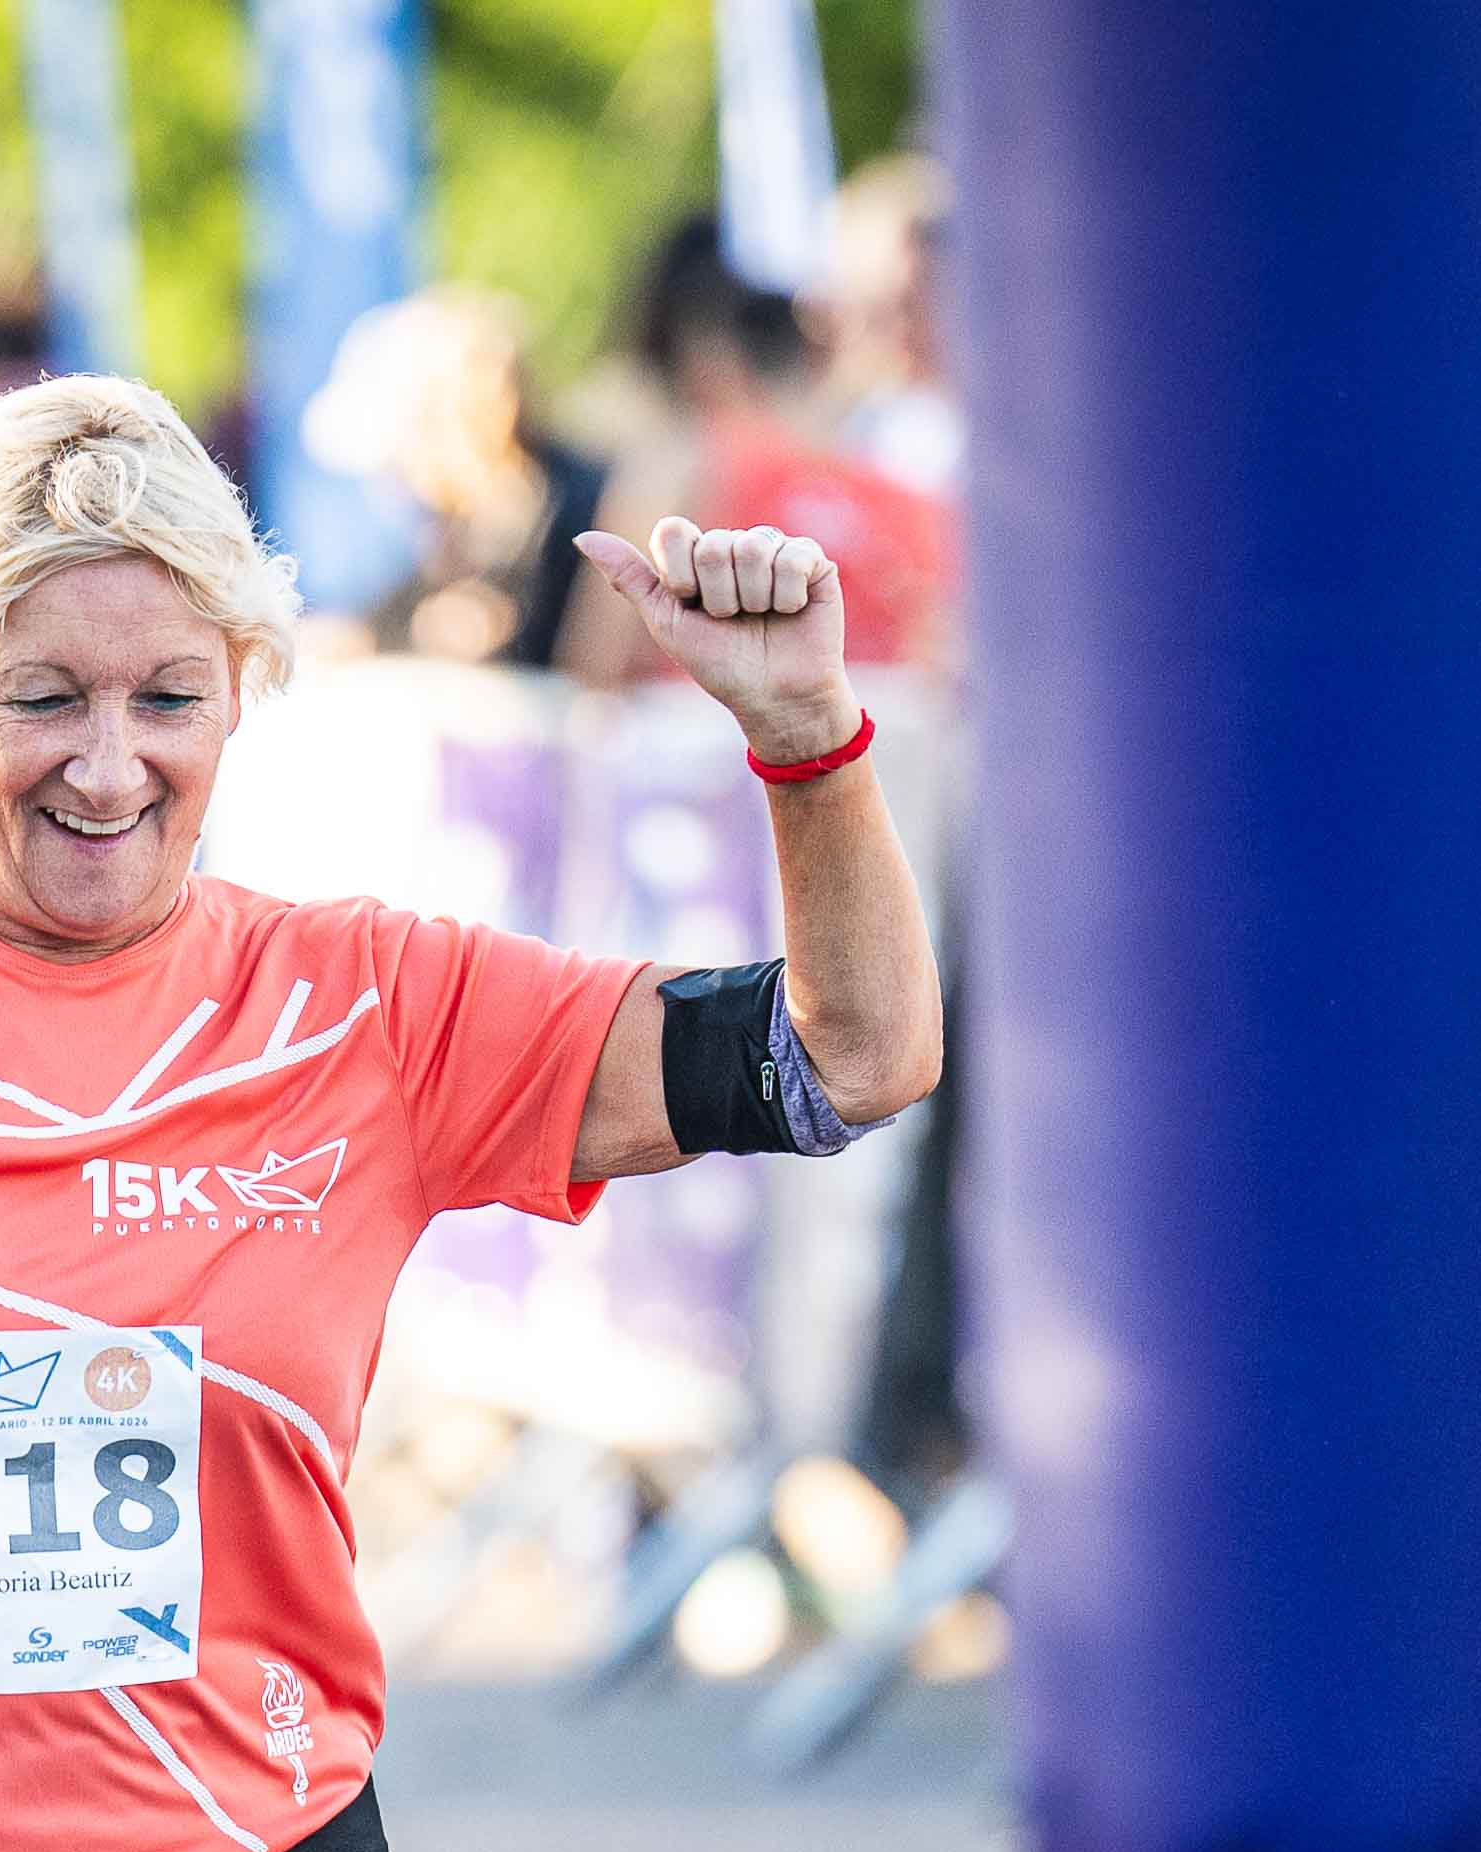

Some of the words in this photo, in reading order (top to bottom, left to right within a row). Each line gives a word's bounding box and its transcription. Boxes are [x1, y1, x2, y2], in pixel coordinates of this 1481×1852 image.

[81, 1157, 219, 1220] 15K
[92, 1216, 220, 1236] PUERTO
[235, 1215, 322, 1235] NORTE
[94, 1366, 138, 1394] 4K
[42, 1416, 54, 1427] 12
[59, 1416, 75, 1426] DE
[78, 1415, 115, 1426] ABRIL
[119, 1416, 149, 1428] 2026
[49, 1565, 134, 1591] Beatriz
[83, 1634, 139, 1650] POWER
[105, 1645, 137, 1659] ADE
[265, 1723, 314, 1758] ARDEC
